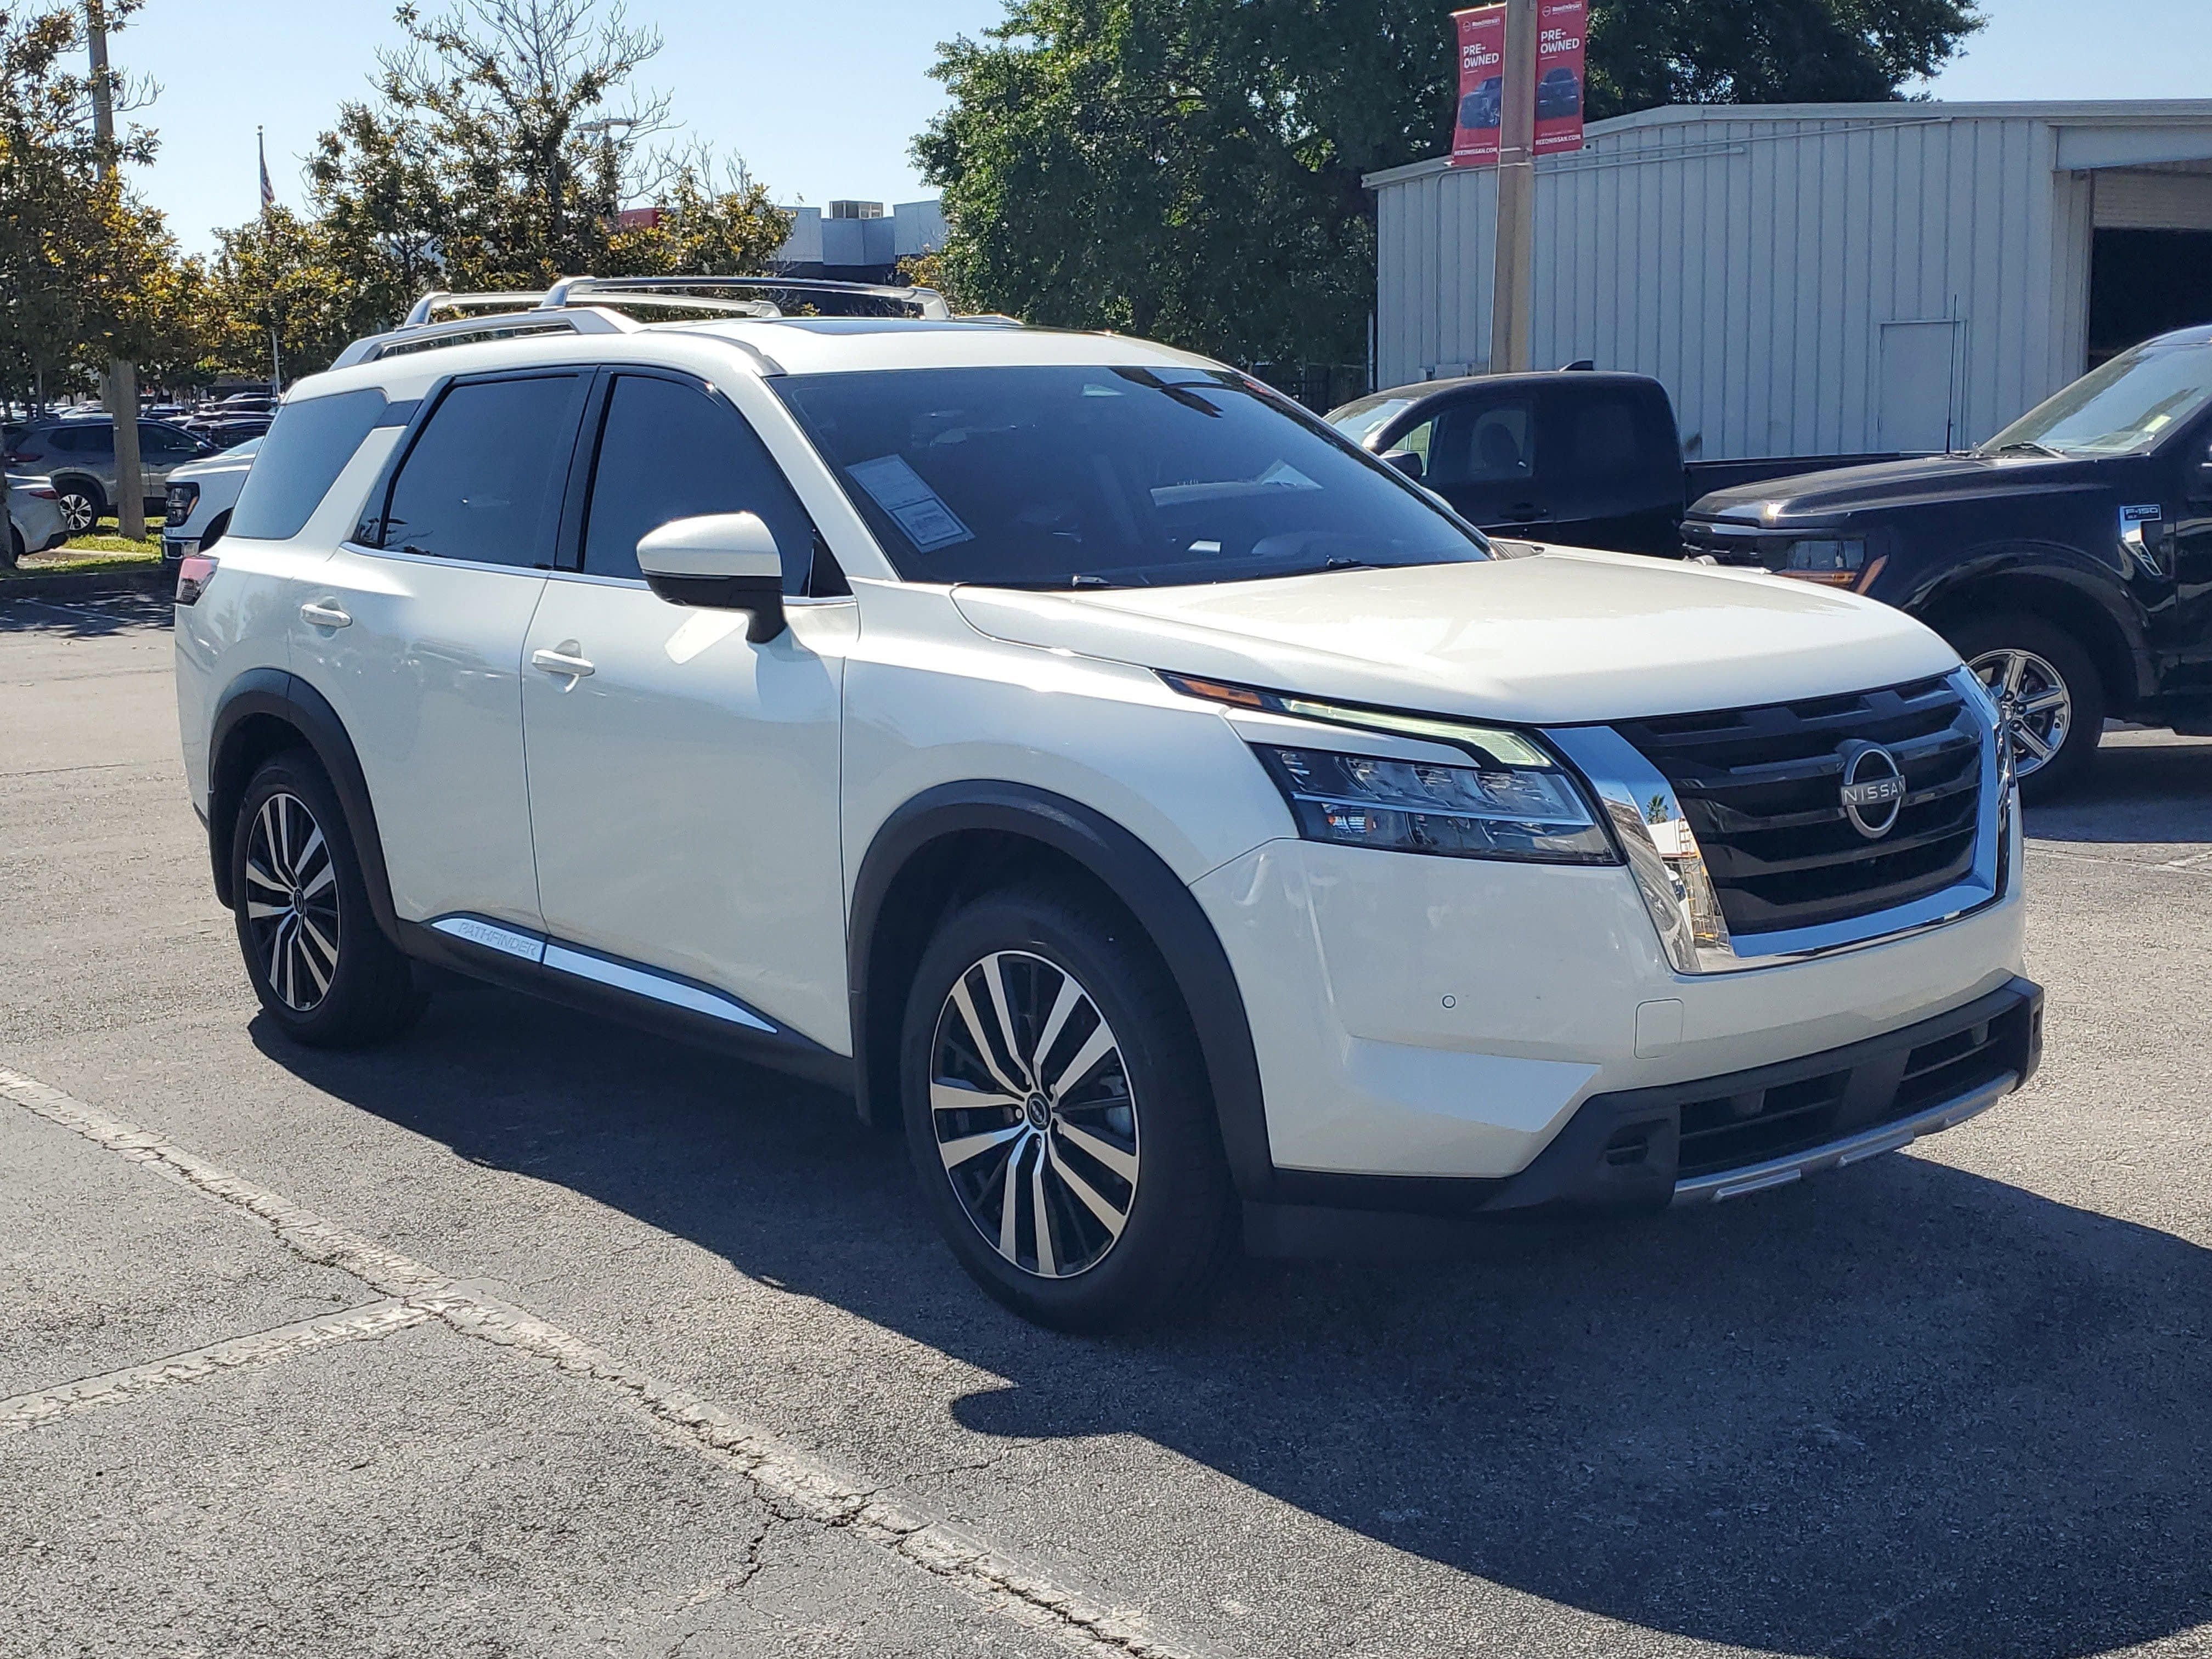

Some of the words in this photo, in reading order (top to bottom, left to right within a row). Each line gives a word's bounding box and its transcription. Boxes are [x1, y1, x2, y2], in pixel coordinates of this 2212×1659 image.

[1541, 29, 1567, 42] PRE-
[1463, 43, 1486, 57] PRE-
[1540, 38, 1580, 54] OWNED
[1464, 53, 1499, 69] OWNED
[1844, 780, 1905, 804] NISSAN
[459, 922, 539, 956] PATHFINDER
